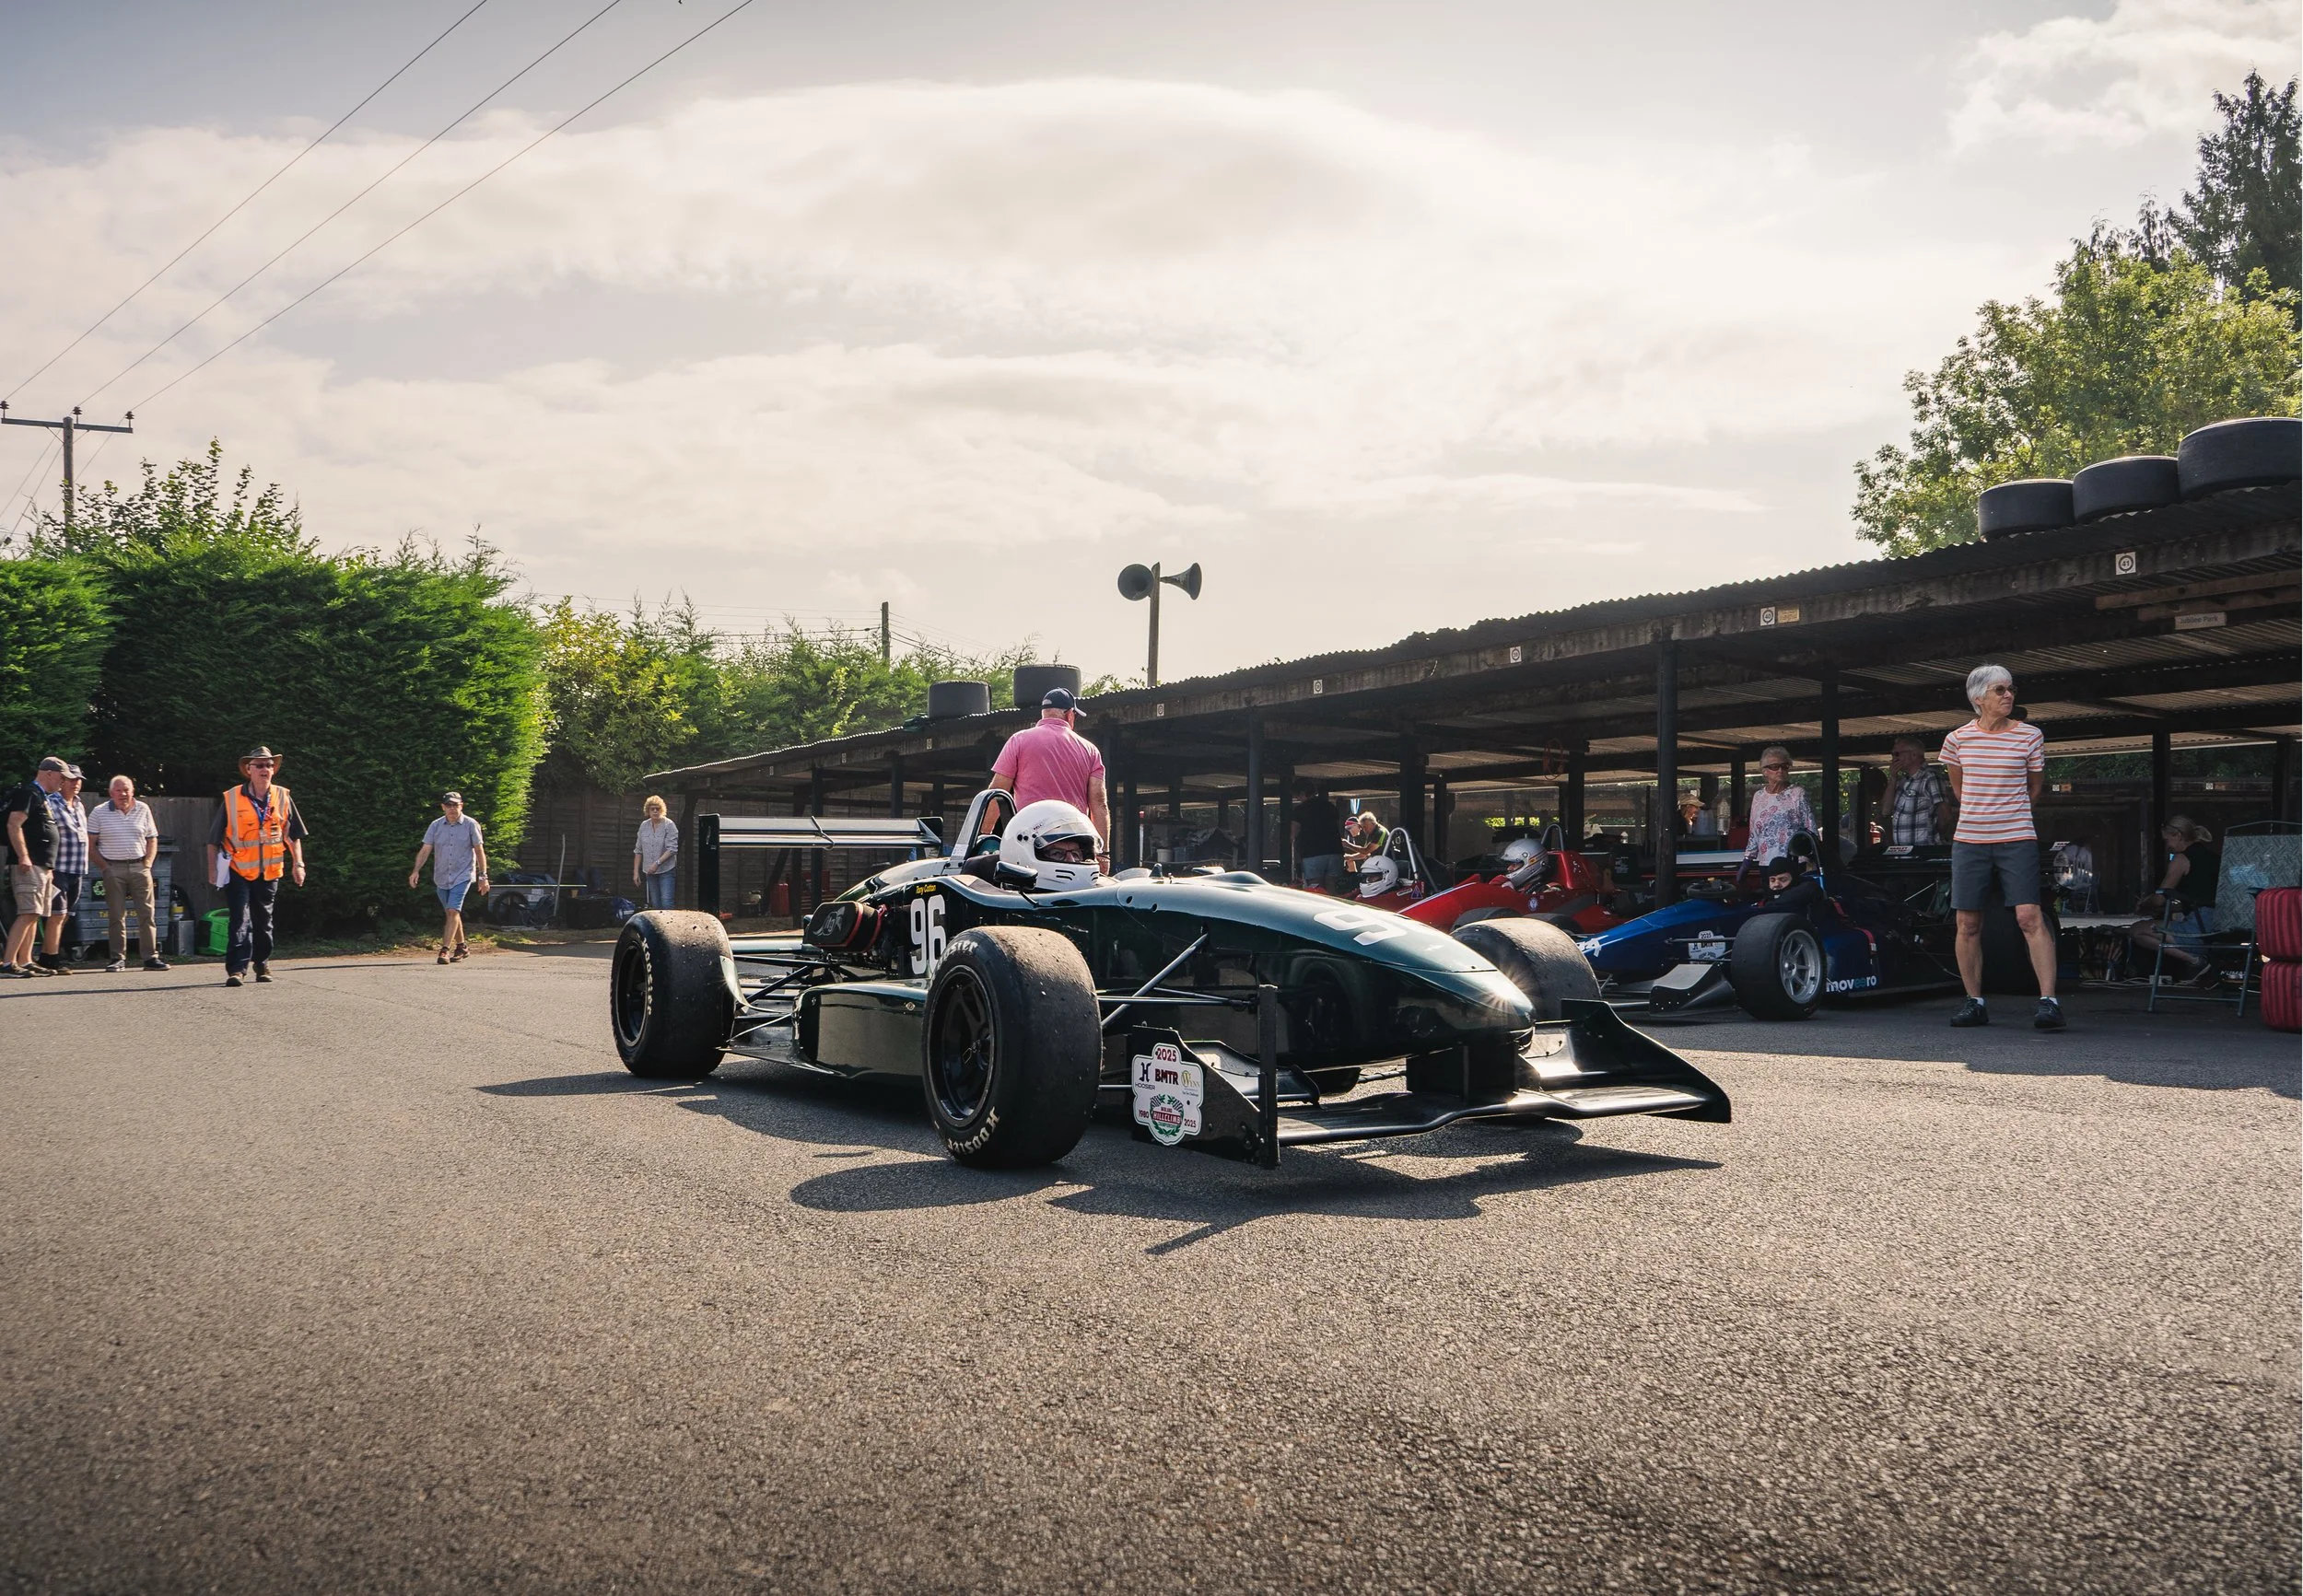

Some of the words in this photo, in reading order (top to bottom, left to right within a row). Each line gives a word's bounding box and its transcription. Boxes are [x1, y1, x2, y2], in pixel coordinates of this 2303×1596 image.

[910, 894, 947, 975] 96
[1157, 1048, 1177, 1062] 2025
[1155, 1068, 1179, 1085] BMTR
[1135, 1082, 1156, 1090] HOOSIER
[1139, 1110, 1150, 1118] 1980
[1152, 1113, 1181, 1123] HILLCLIMB
[1184, 1118, 1197, 1127] 2025
[947, 1106, 1000, 1154] Hoosier
